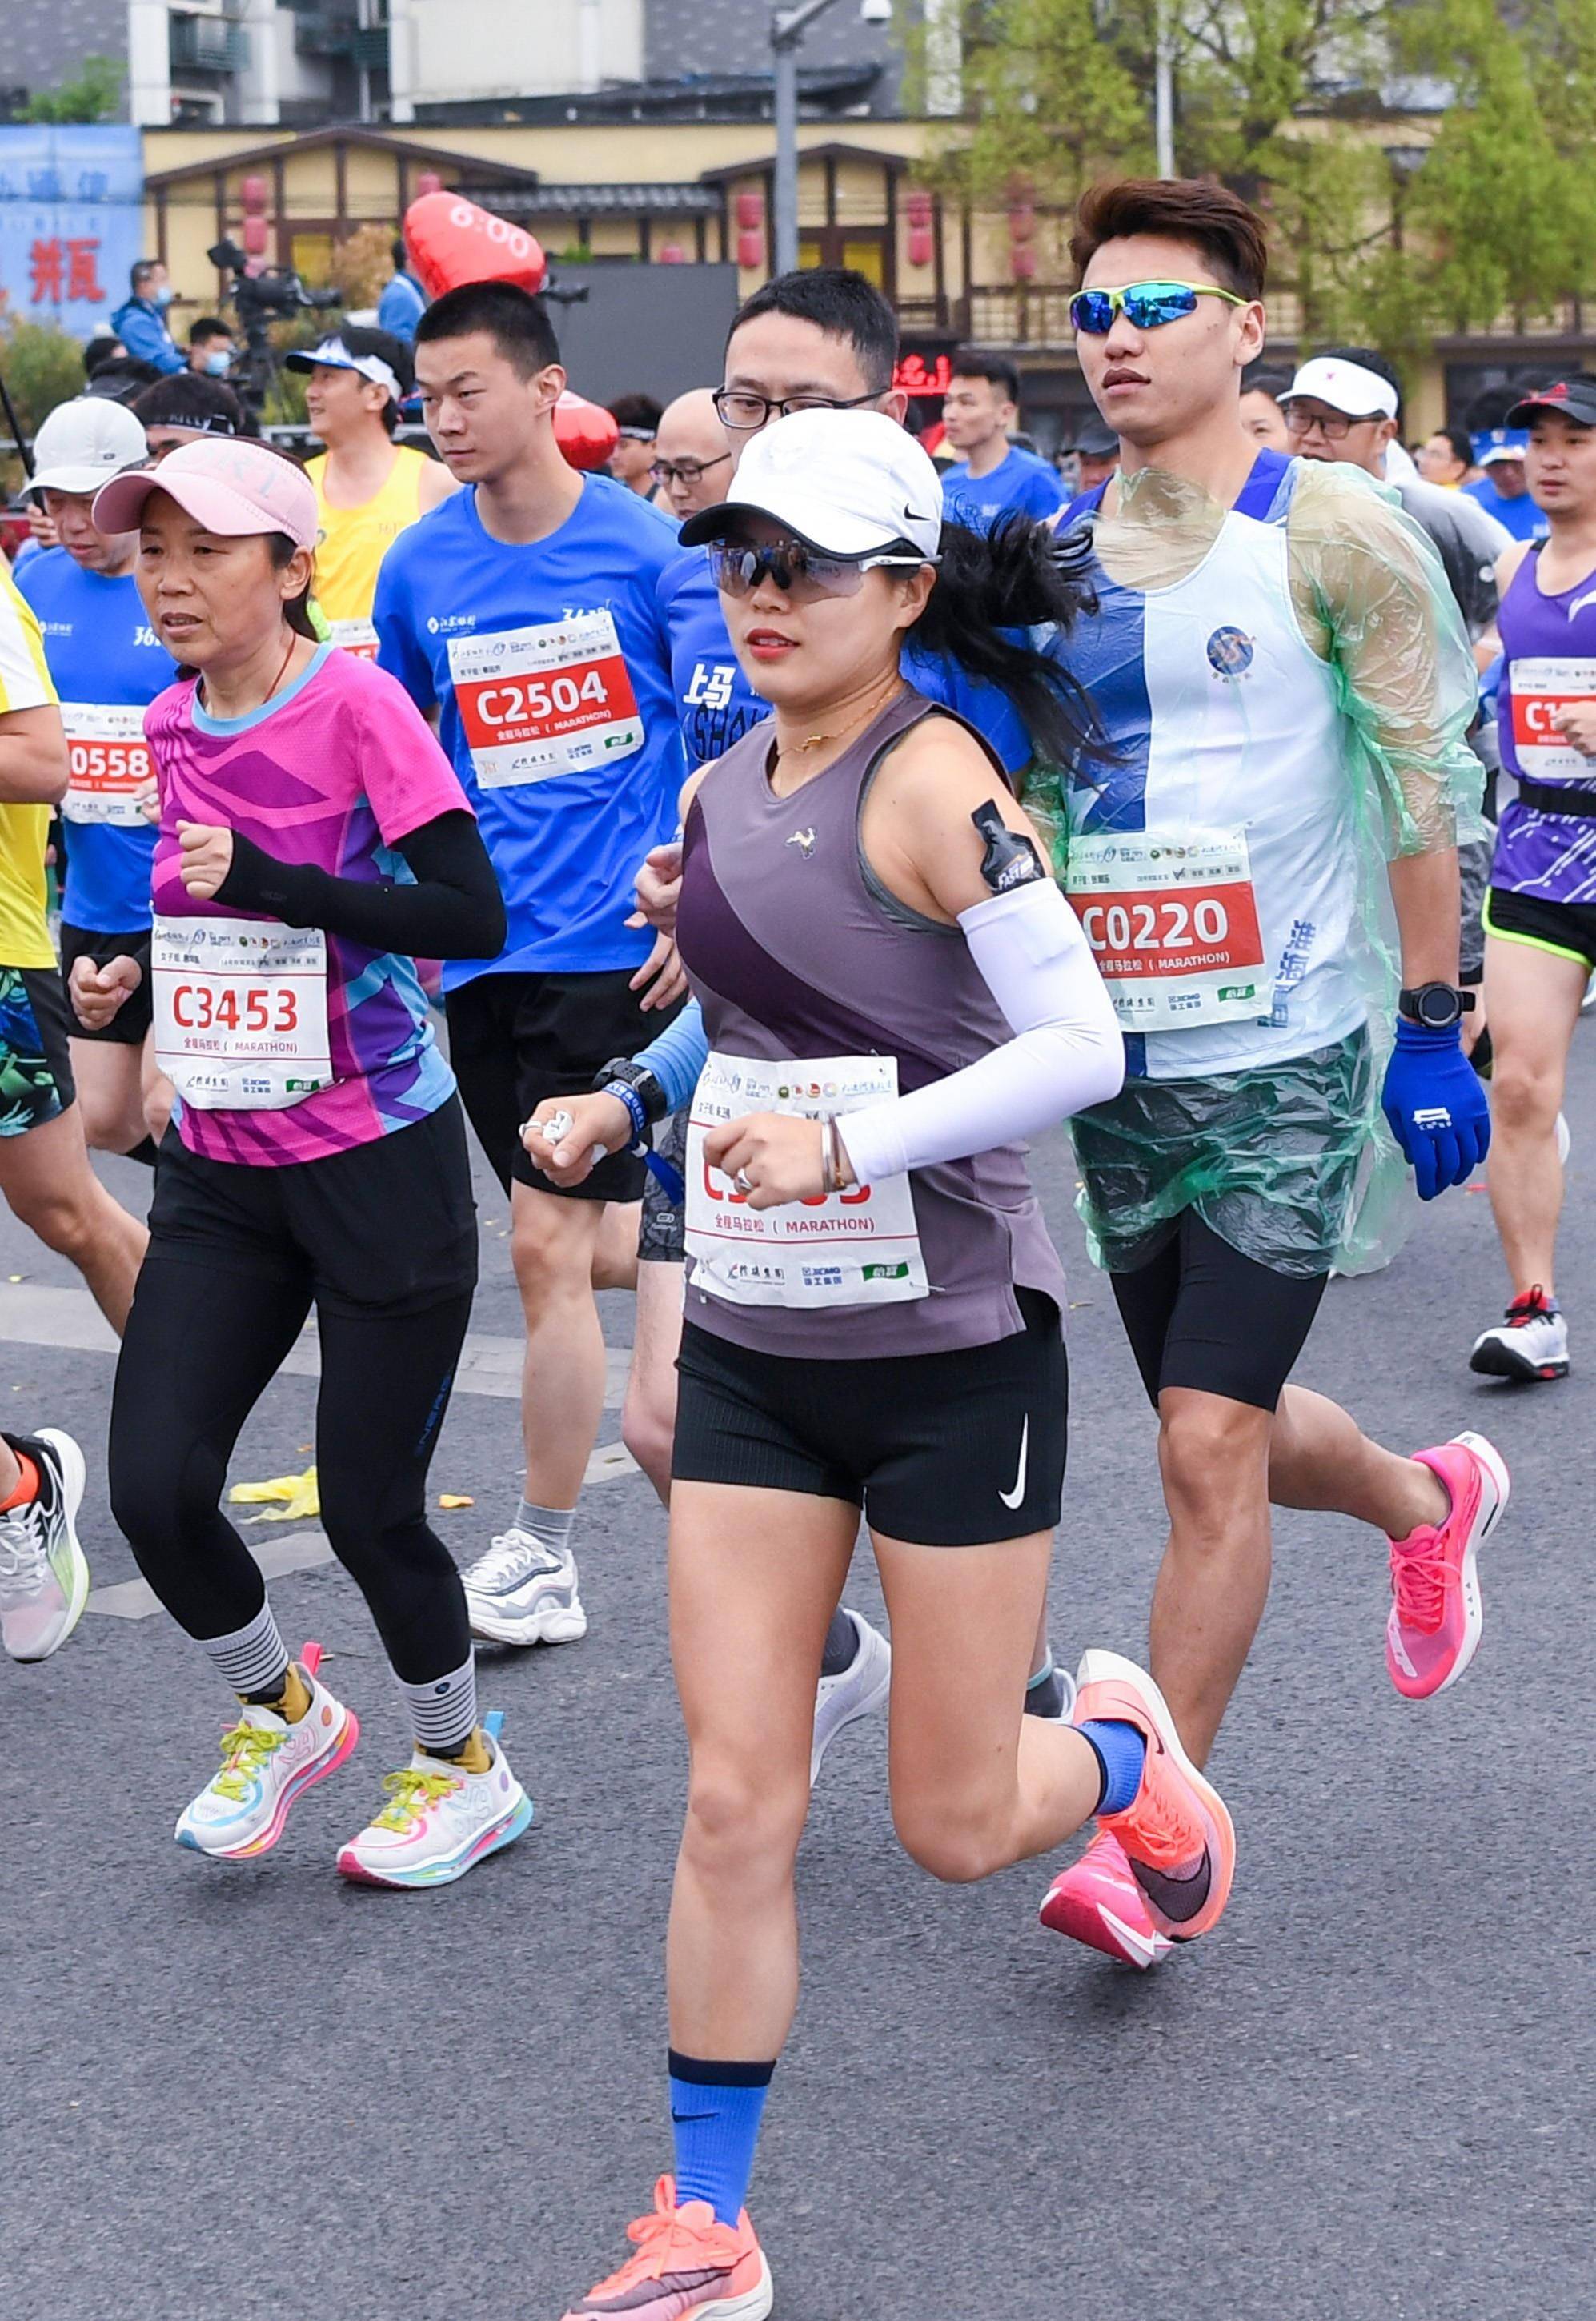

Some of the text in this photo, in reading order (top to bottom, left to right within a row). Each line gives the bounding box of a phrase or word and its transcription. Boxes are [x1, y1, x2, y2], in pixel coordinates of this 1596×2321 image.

[450, 203, 530, 259] 6:00
[477, 671, 608, 725] C2504
[71, 746, 150, 777] 0558
[1083, 899, 1229, 952] C0220
[174, 985, 298, 1032] C3453
[184, 1037, 220, 1051] 全程马拉松
[715, 1213, 764, 1232] 全程马拉松
